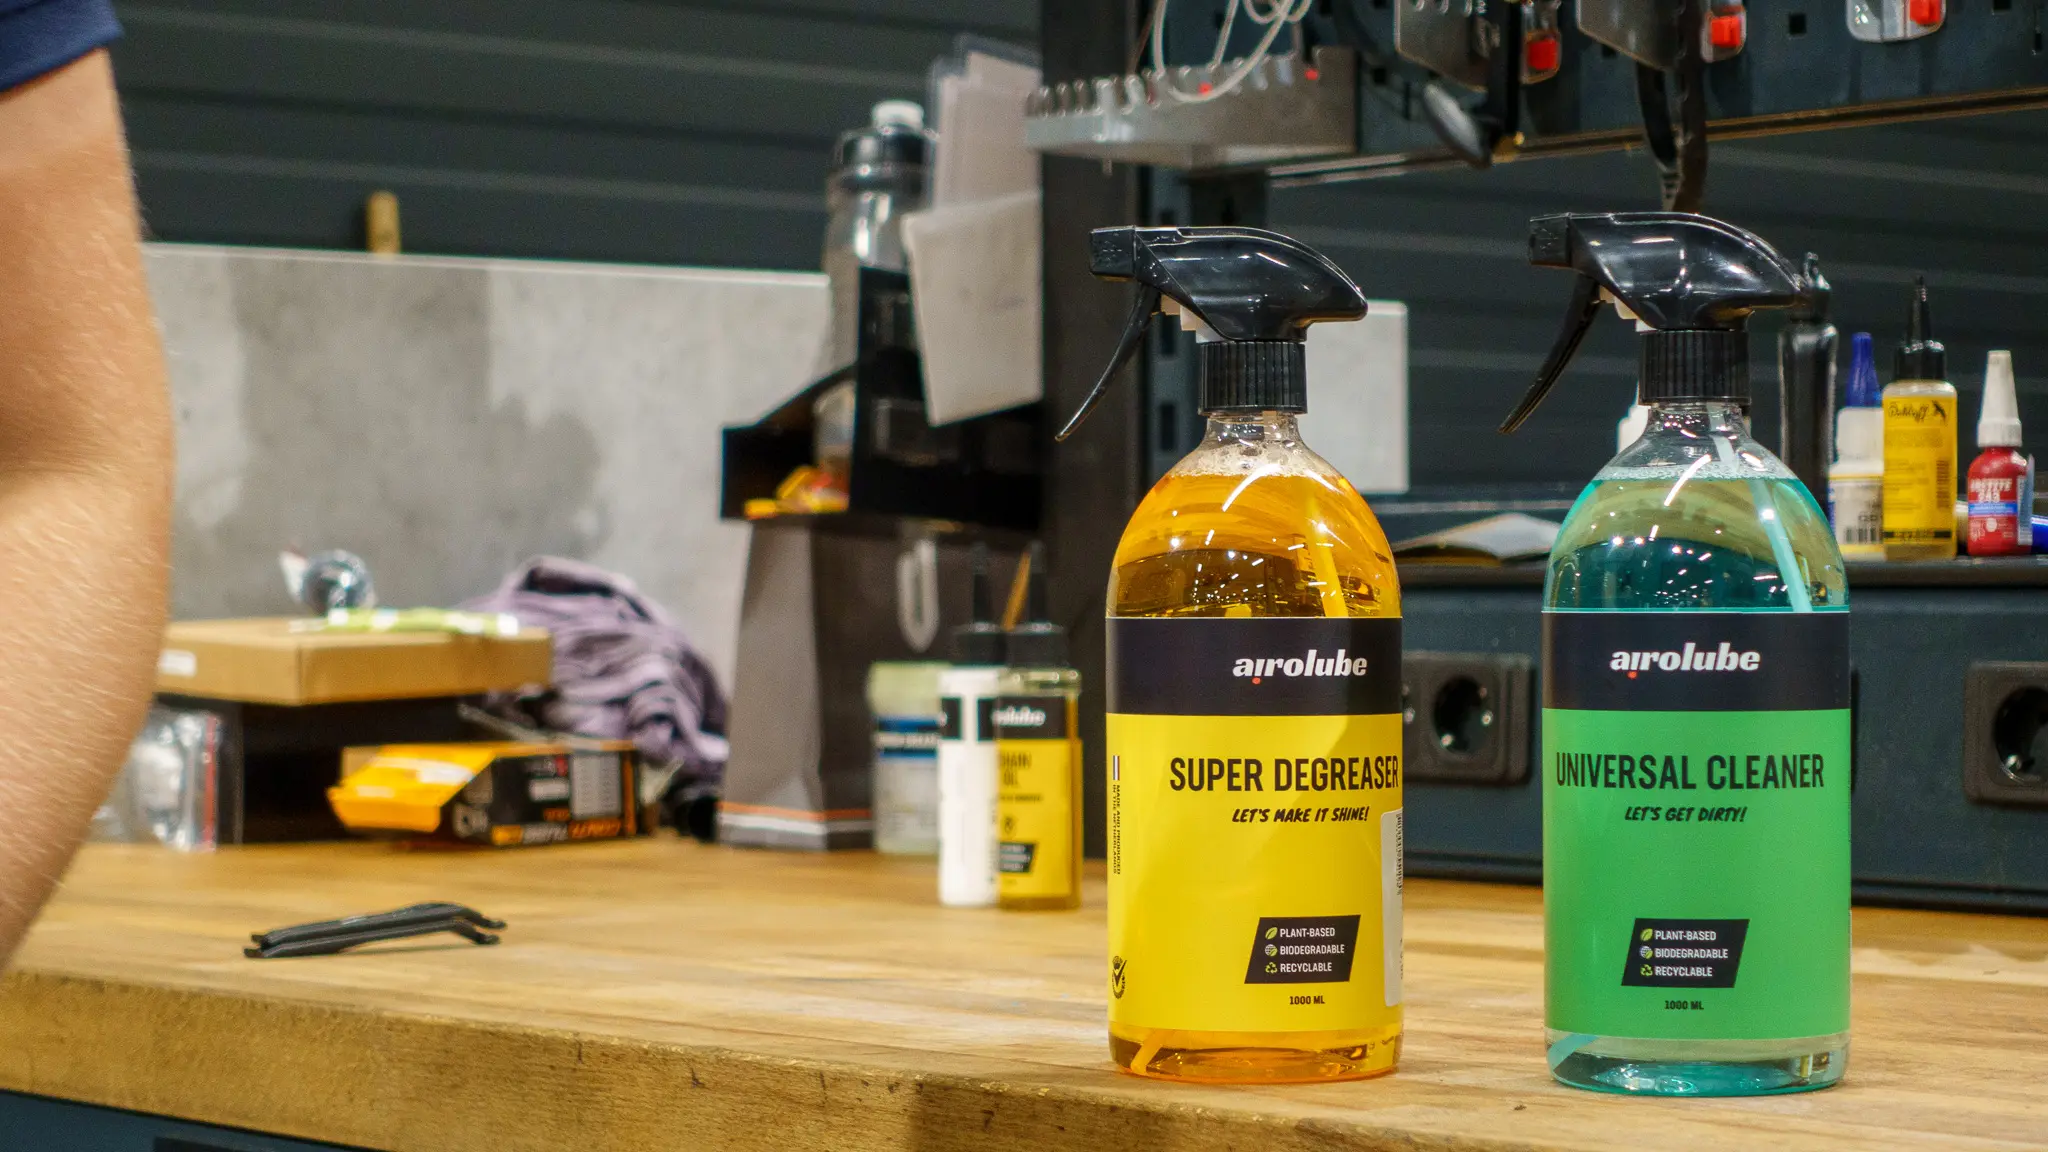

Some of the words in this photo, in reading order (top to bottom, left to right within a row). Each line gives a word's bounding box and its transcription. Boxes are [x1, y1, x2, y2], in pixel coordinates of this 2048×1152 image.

[1609, 642, 1761, 678] airolube
[1232, 649, 1368, 684] airolube
[1169, 756, 1263, 792] SUPER
[1274, 755, 1399, 791] DEGREASER
[1556, 752, 1697, 790] UNIVERSAL
[1706, 753, 1824, 791] CLEANER
[1231, 808, 1270, 823] LET'S
[1273, 808, 1312, 823] MAKE
[1314, 807, 1329, 822] IT
[1330, 805, 1370, 822] SHINE!
[1624, 806, 1662, 822] LET'S
[1665, 806, 1695, 823] GET
[1697, 806, 1748, 823] DIRTY!
[1279, 927, 1336, 938] PLANT-BASED
[1654, 930, 1717, 941] PLANT-BASED
[1279, 944, 1345, 956] BIODEGRADABLE
[1654, 948, 1729, 959] BIODEGRADABLE
[1279, 962, 1333, 973] RECYCLABLE
[1654, 965, 1713, 977] RECYCLABLE
[1289, 995, 1312, 1005] 1000
[1313, 995, 1326, 1004] ML
[1664, 1000, 1689, 1010] 1000
[1690, 1000, 1705, 1010] ML
